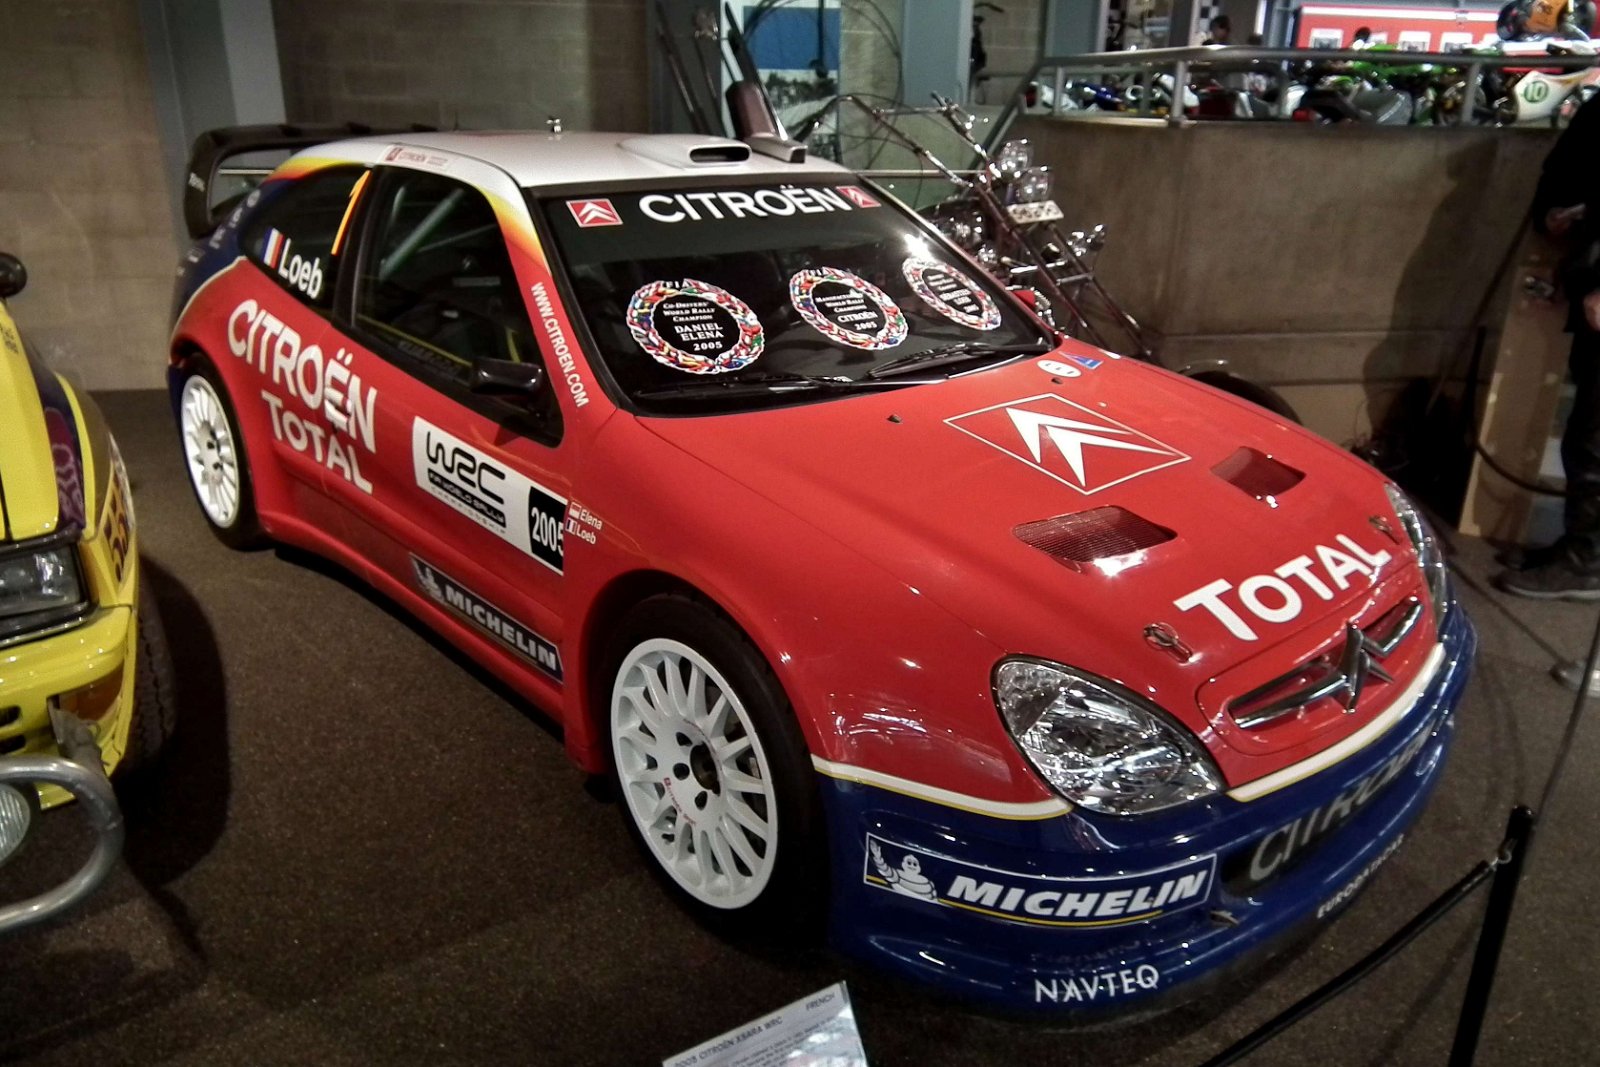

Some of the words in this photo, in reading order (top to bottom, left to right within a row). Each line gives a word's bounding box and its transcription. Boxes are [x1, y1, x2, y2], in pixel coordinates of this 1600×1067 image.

[1525, 83, 1546, 102] 10
[331, 170, 371, 256] 1
[638, 184, 853, 223] CITROËN
[278, 238, 323, 299] Loeb
[666, 281, 690, 289] FIA
[674, 323, 723, 333] DANIEL
[837, 310, 878, 322] CITROËN
[854, 321, 877, 331] 2005
[530, 282, 590, 407] WWW.CITROEN.COM
[680, 331, 724, 341] ELENA
[693, 341, 723, 351] 2005
[228, 299, 377, 454] CITROËN
[261, 389, 373, 494] TOTAL
[426, 431, 506, 505] WRC
[577, 525, 596, 545] Loeb
[580, 509, 603, 530] Elena
[1172, 534, 1392, 641] TOTAL
[445, 584, 557, 671] MICHELIN
[946, 870, 1208, 918] MICHELIN
[1034, 964, 1160, 1003] NAVTEQ
